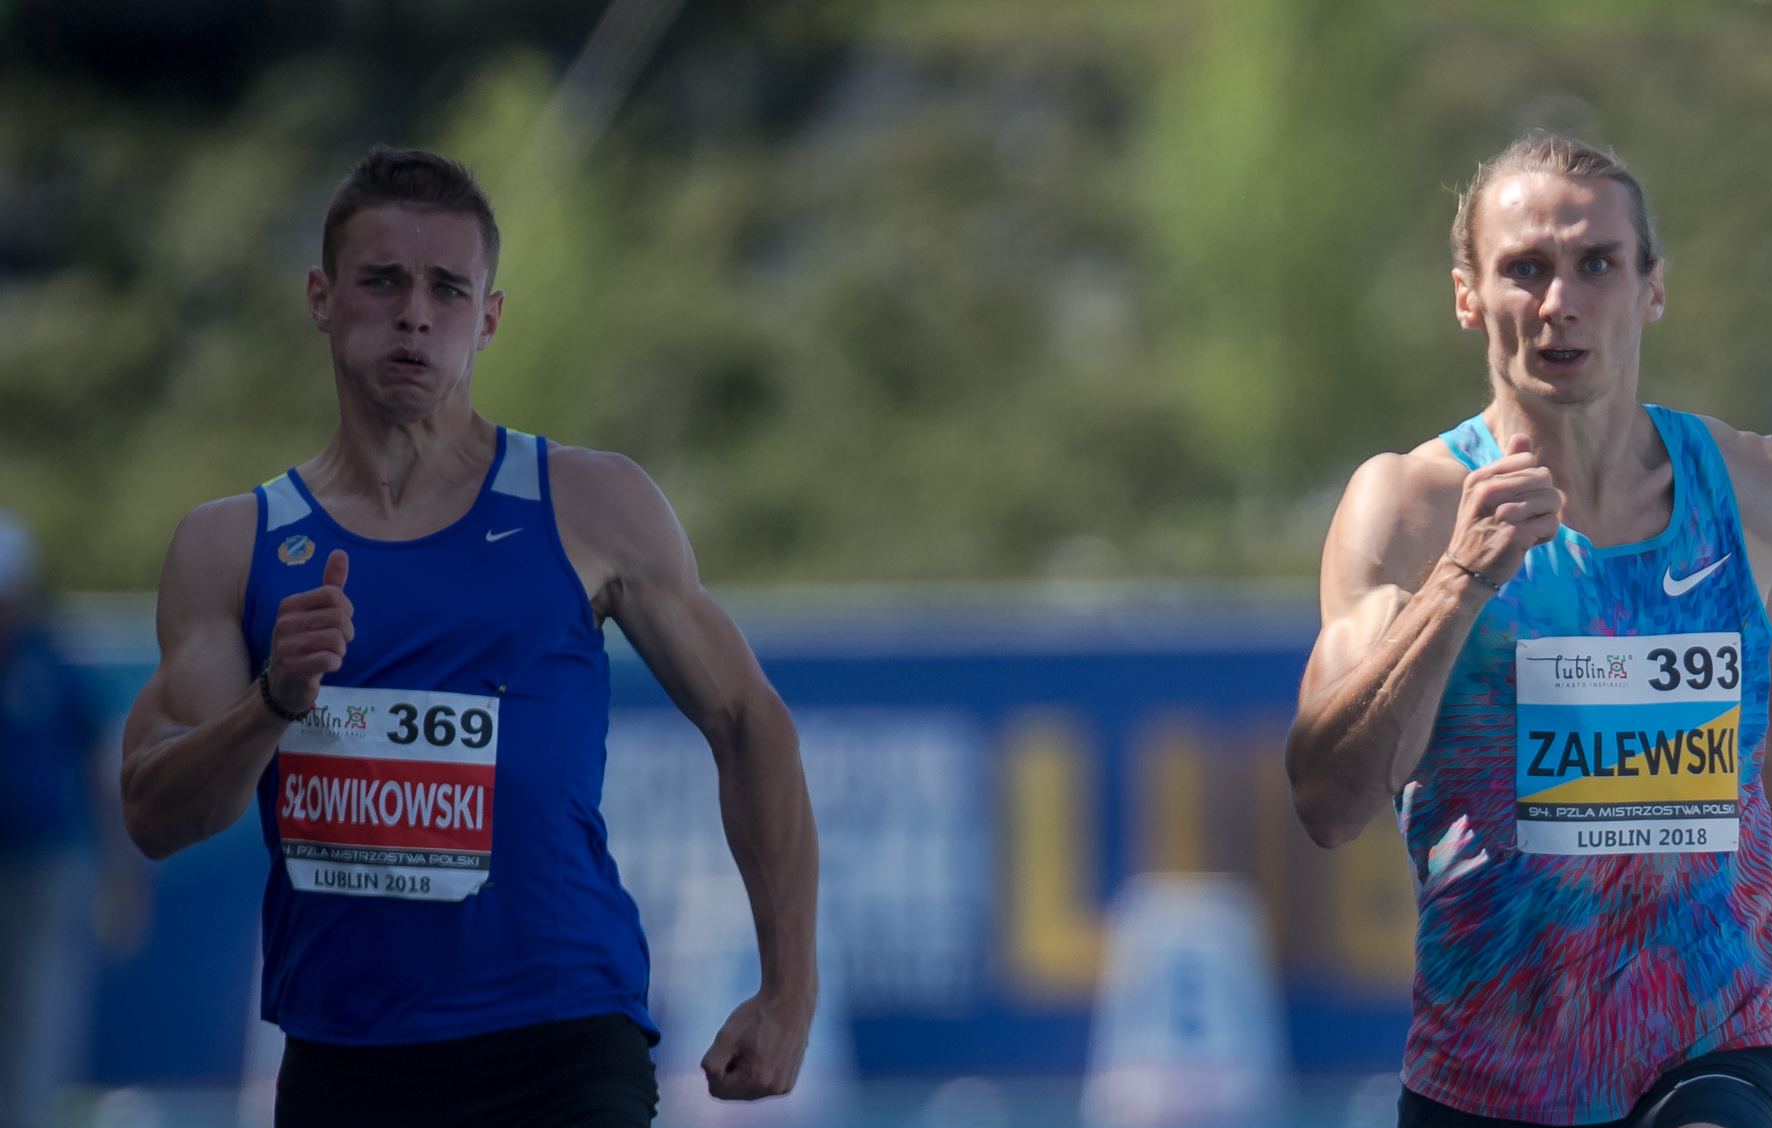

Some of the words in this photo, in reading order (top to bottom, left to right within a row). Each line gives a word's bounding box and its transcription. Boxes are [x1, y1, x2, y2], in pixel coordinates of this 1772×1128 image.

[1527, 654, 1606, 680] lublin
[1646, 645, 1740, 692] 393
[301, 705, 341, 728] ublin
[386, 702, 494, 749] 369
[1526, 728, 1735, 778] ZALEWSKI
[281, 773, 484, 830] SŁOWIKOWSKI
[1529, 806, 1552, 818] 94.
[1556, 806, 1596, 818] PZLA
[1598, 803, 1702, 818] MISTRZOSTWA
[1703, 803, 1735, 815] POLSKI
[1577, 829, 1651, 848] LUBLIN
[1658, 828, 1708, 846] 2018
[297, 848, 329, 858] PZLA
[331, 849, 426, 863] MISTRZOSTWA
[429, 854, 479, 867] POLSKI
[314, 868, 378, 889] LUBLIN
[385, 874, 431, 893] 2018
